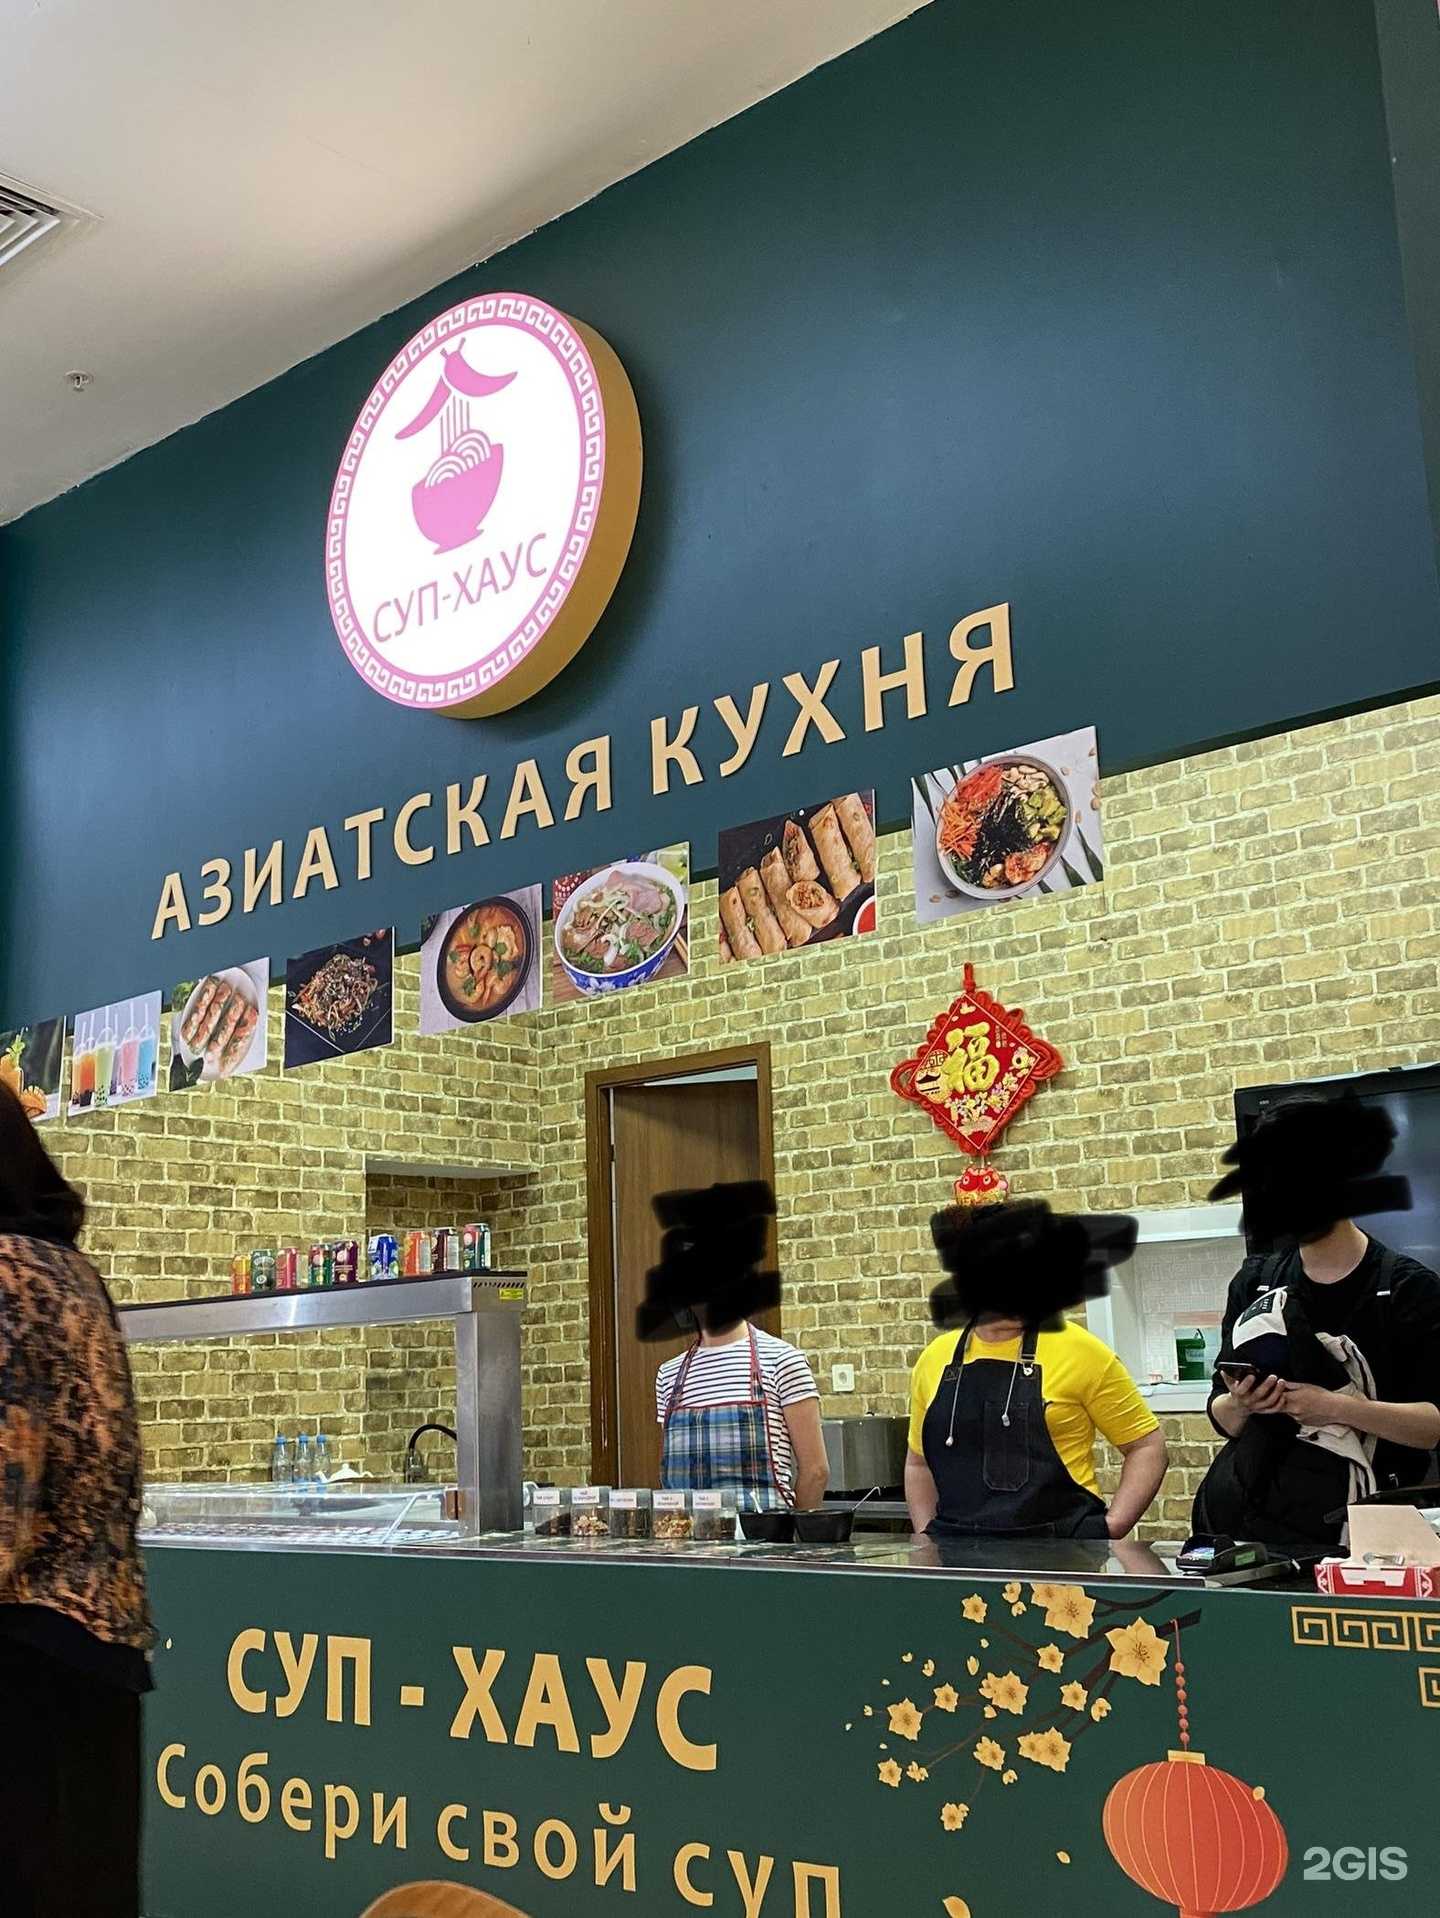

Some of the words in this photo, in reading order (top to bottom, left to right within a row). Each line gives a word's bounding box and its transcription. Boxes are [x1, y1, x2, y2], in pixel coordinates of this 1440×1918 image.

[372, 532, 548, 644] СУП-ХАУС
[150, 735, 613, 941] АЗИАТСКАЯ
[649, 602, 1017, 797] КУХНЯ
[942, 1021, 1000, 1094] 福
[227, 1627, 373, 1727] СУП
[449, 1645, 718, 1772] ХАУС
[156, 1743, 408, 1860] Собери
[436, 1802, 637, 1892] свой
[672, 1842, 842, 1918] суп
